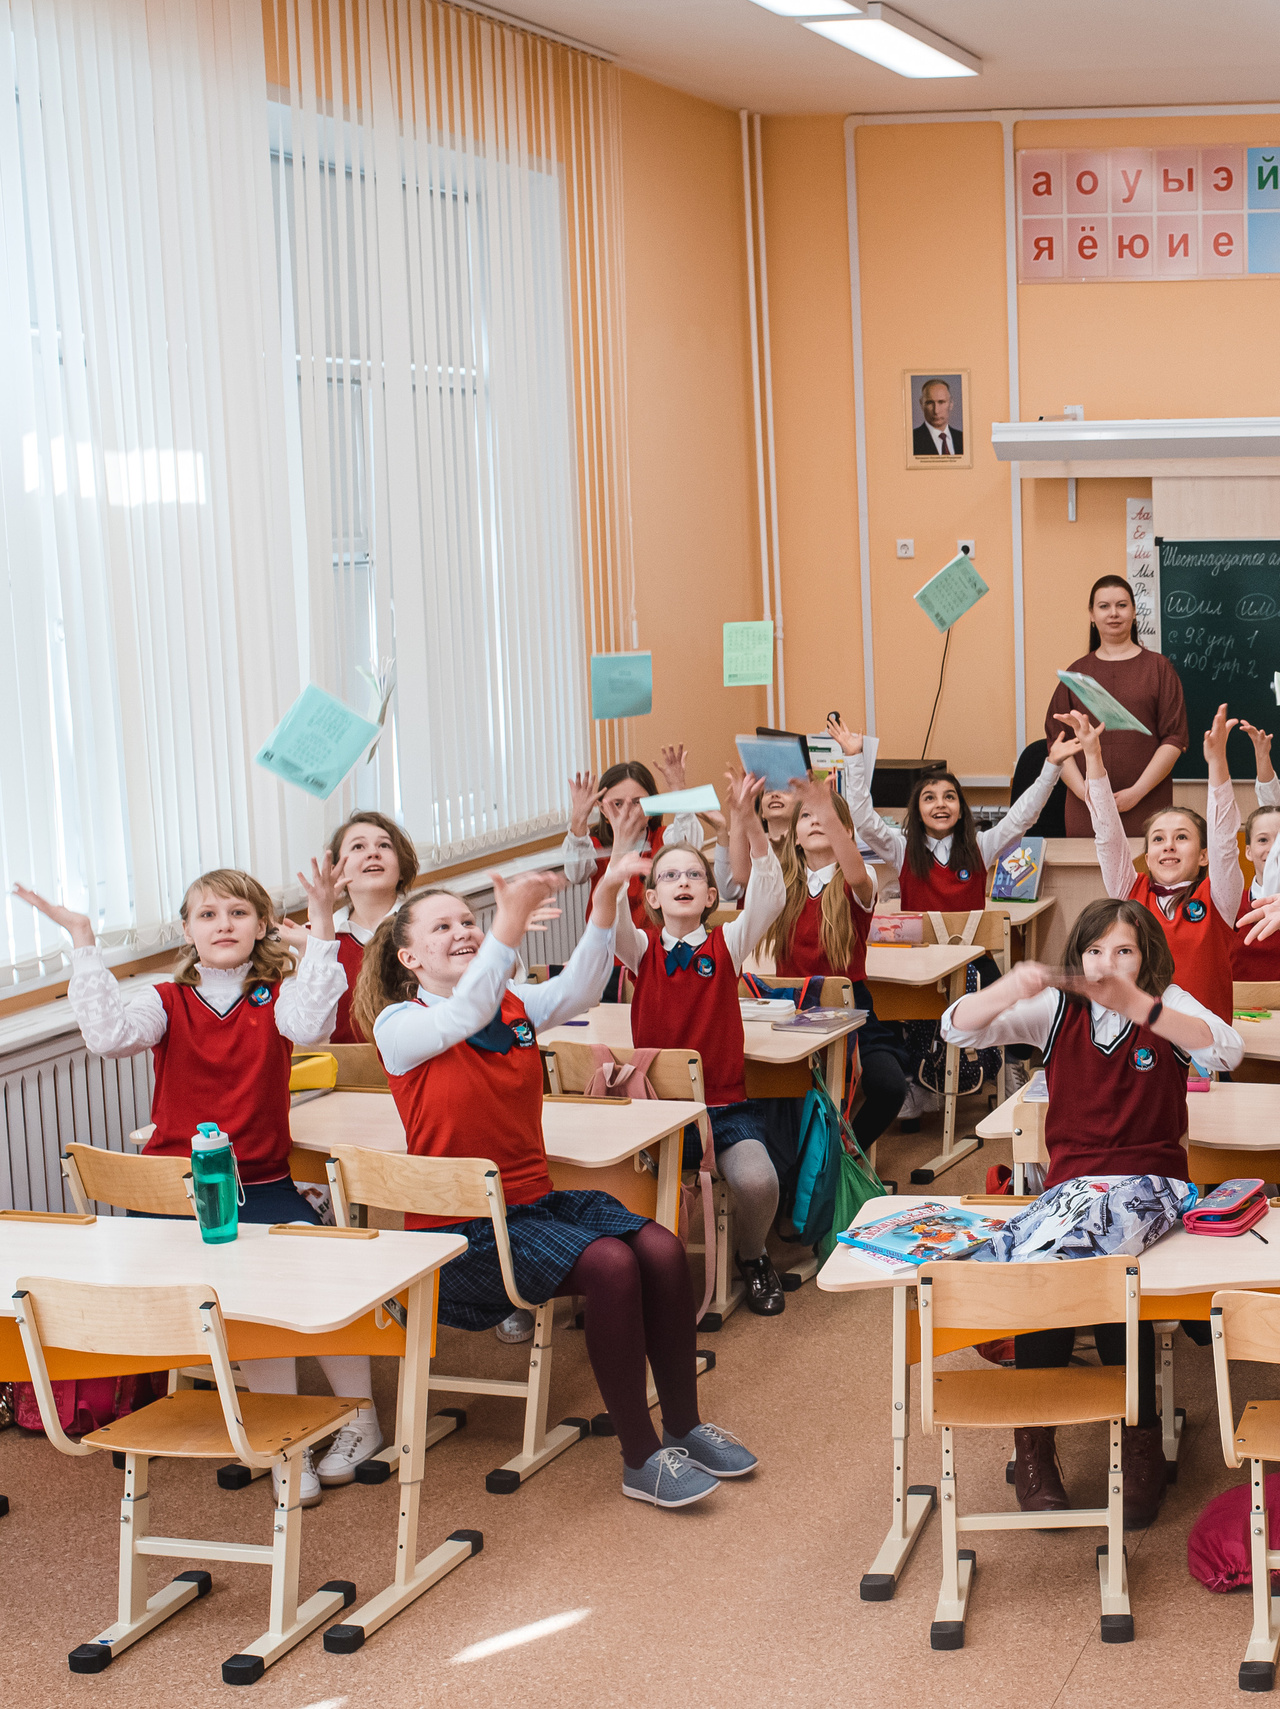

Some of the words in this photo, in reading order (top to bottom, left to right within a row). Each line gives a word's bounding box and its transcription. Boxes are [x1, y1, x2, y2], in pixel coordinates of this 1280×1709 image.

[1033, 172, 1052, 196] а
[1076, 171, 1098, 195] о
[1121, 168, 1143, 203] у
[1163, 168, 1193, 192] ы
[1213, 167, 1233, 191] э
[1258, 156, 1278, 190] й
[1033, 237, 1053, 260] я
[1078, 226, 1097, 259] ё
[1118, 234, 1149, 258] ю
[1169, 234, 1188, 257] и
[1213, 232, 1233, 256] е
[1131, 506, 1152, 520] Аа
[1133, 525, 1146, 540] Ее
[1134, 545, 1151, 559] Ии
[1162, 544, 1264, 576] Шестнадцатое
[1184, 627, 1205, 646] 98
[1247, 630, 1259, 648] 1
[1184, 652, 1207, 671] 100
[1247, 659, 1259, 679] 2
